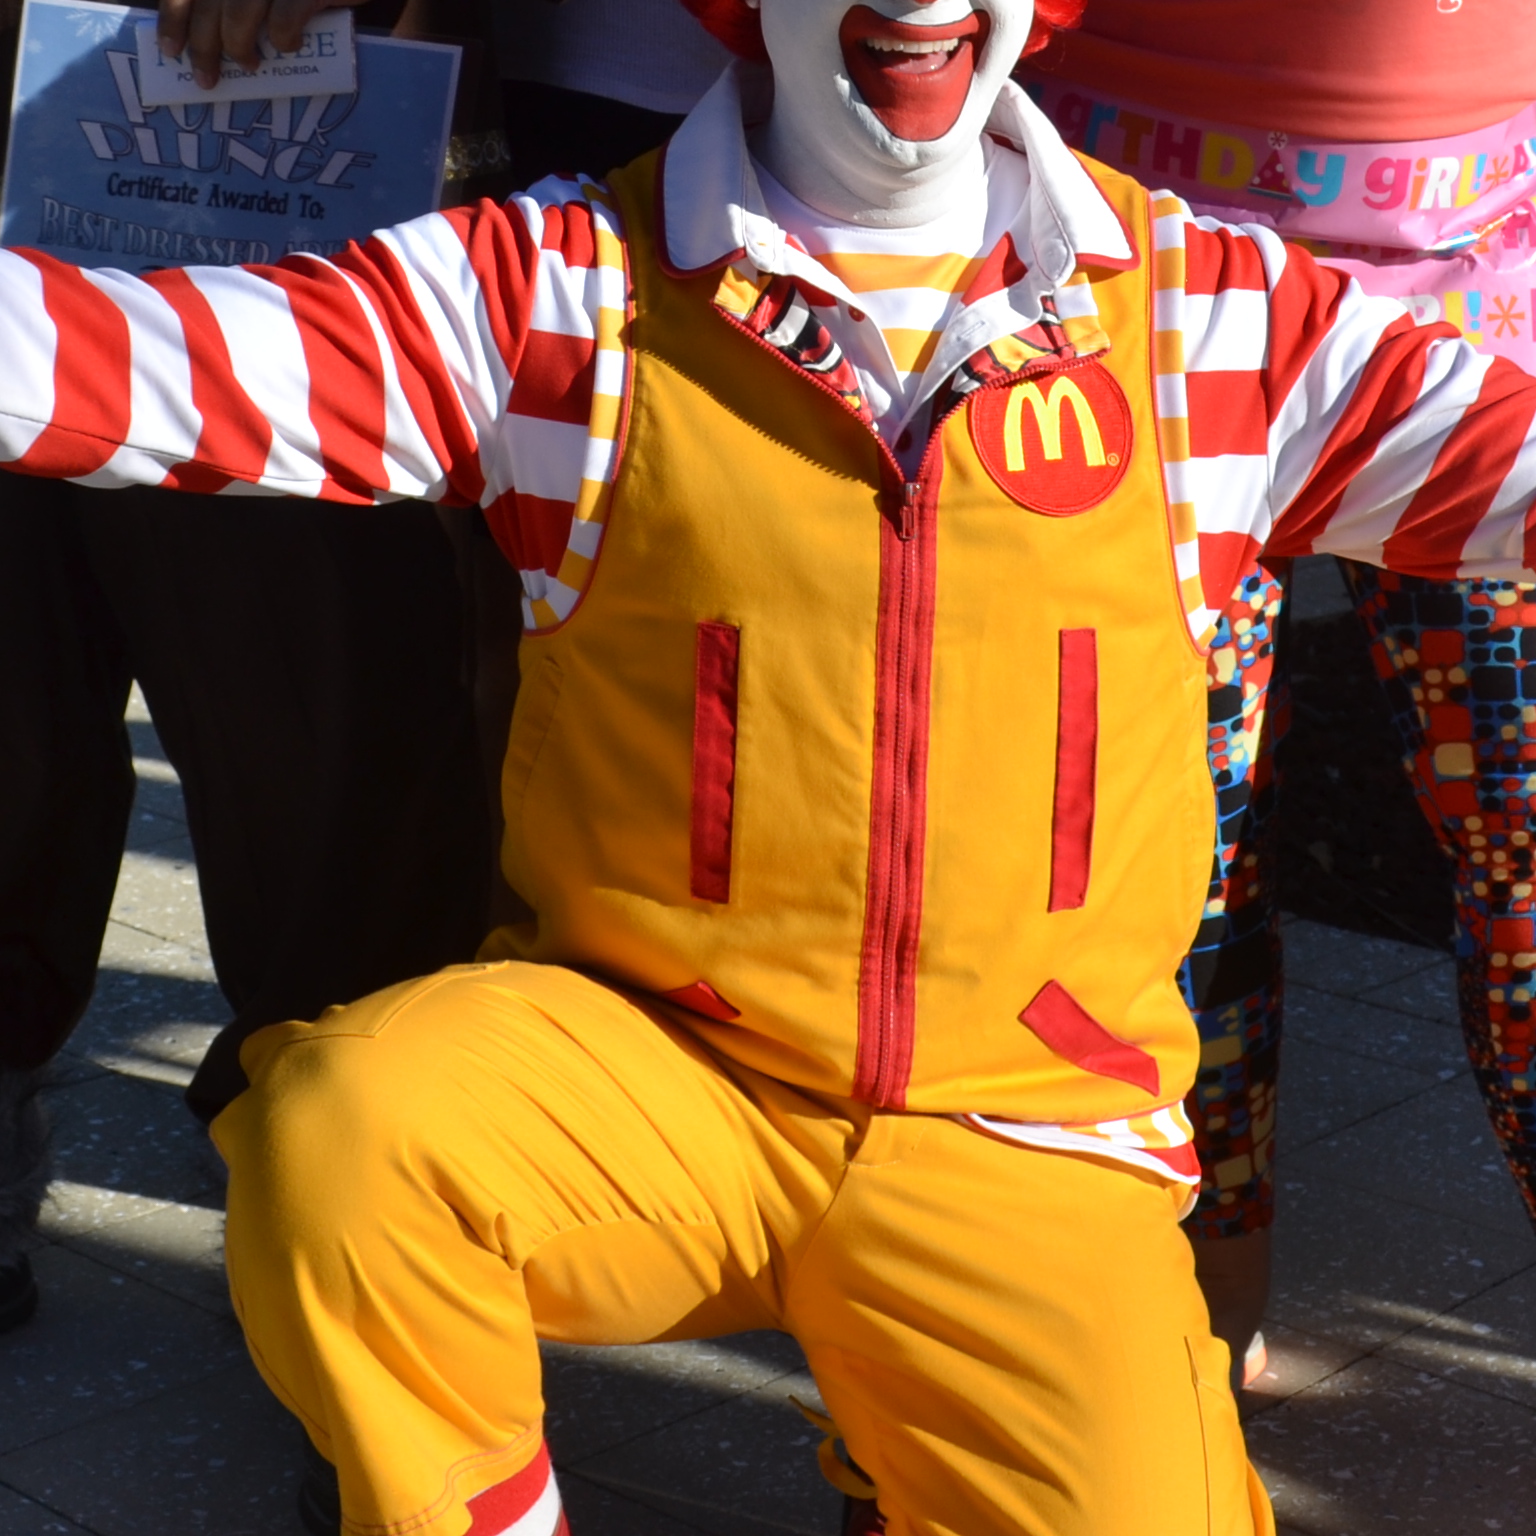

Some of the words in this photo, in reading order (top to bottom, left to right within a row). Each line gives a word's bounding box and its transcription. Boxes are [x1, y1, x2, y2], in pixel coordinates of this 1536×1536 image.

[272, 64, 320, 78] FLORIDA
[75, 118, 377, 190] PLUNGE
[106, 171, 199, 207] Certificate
[205, 184, 289, 217] Awarded
[298, 194, 325, 221] To:
[37, 196, 119, 253] BEST
[121, 220, 270, 265] DRESSED
